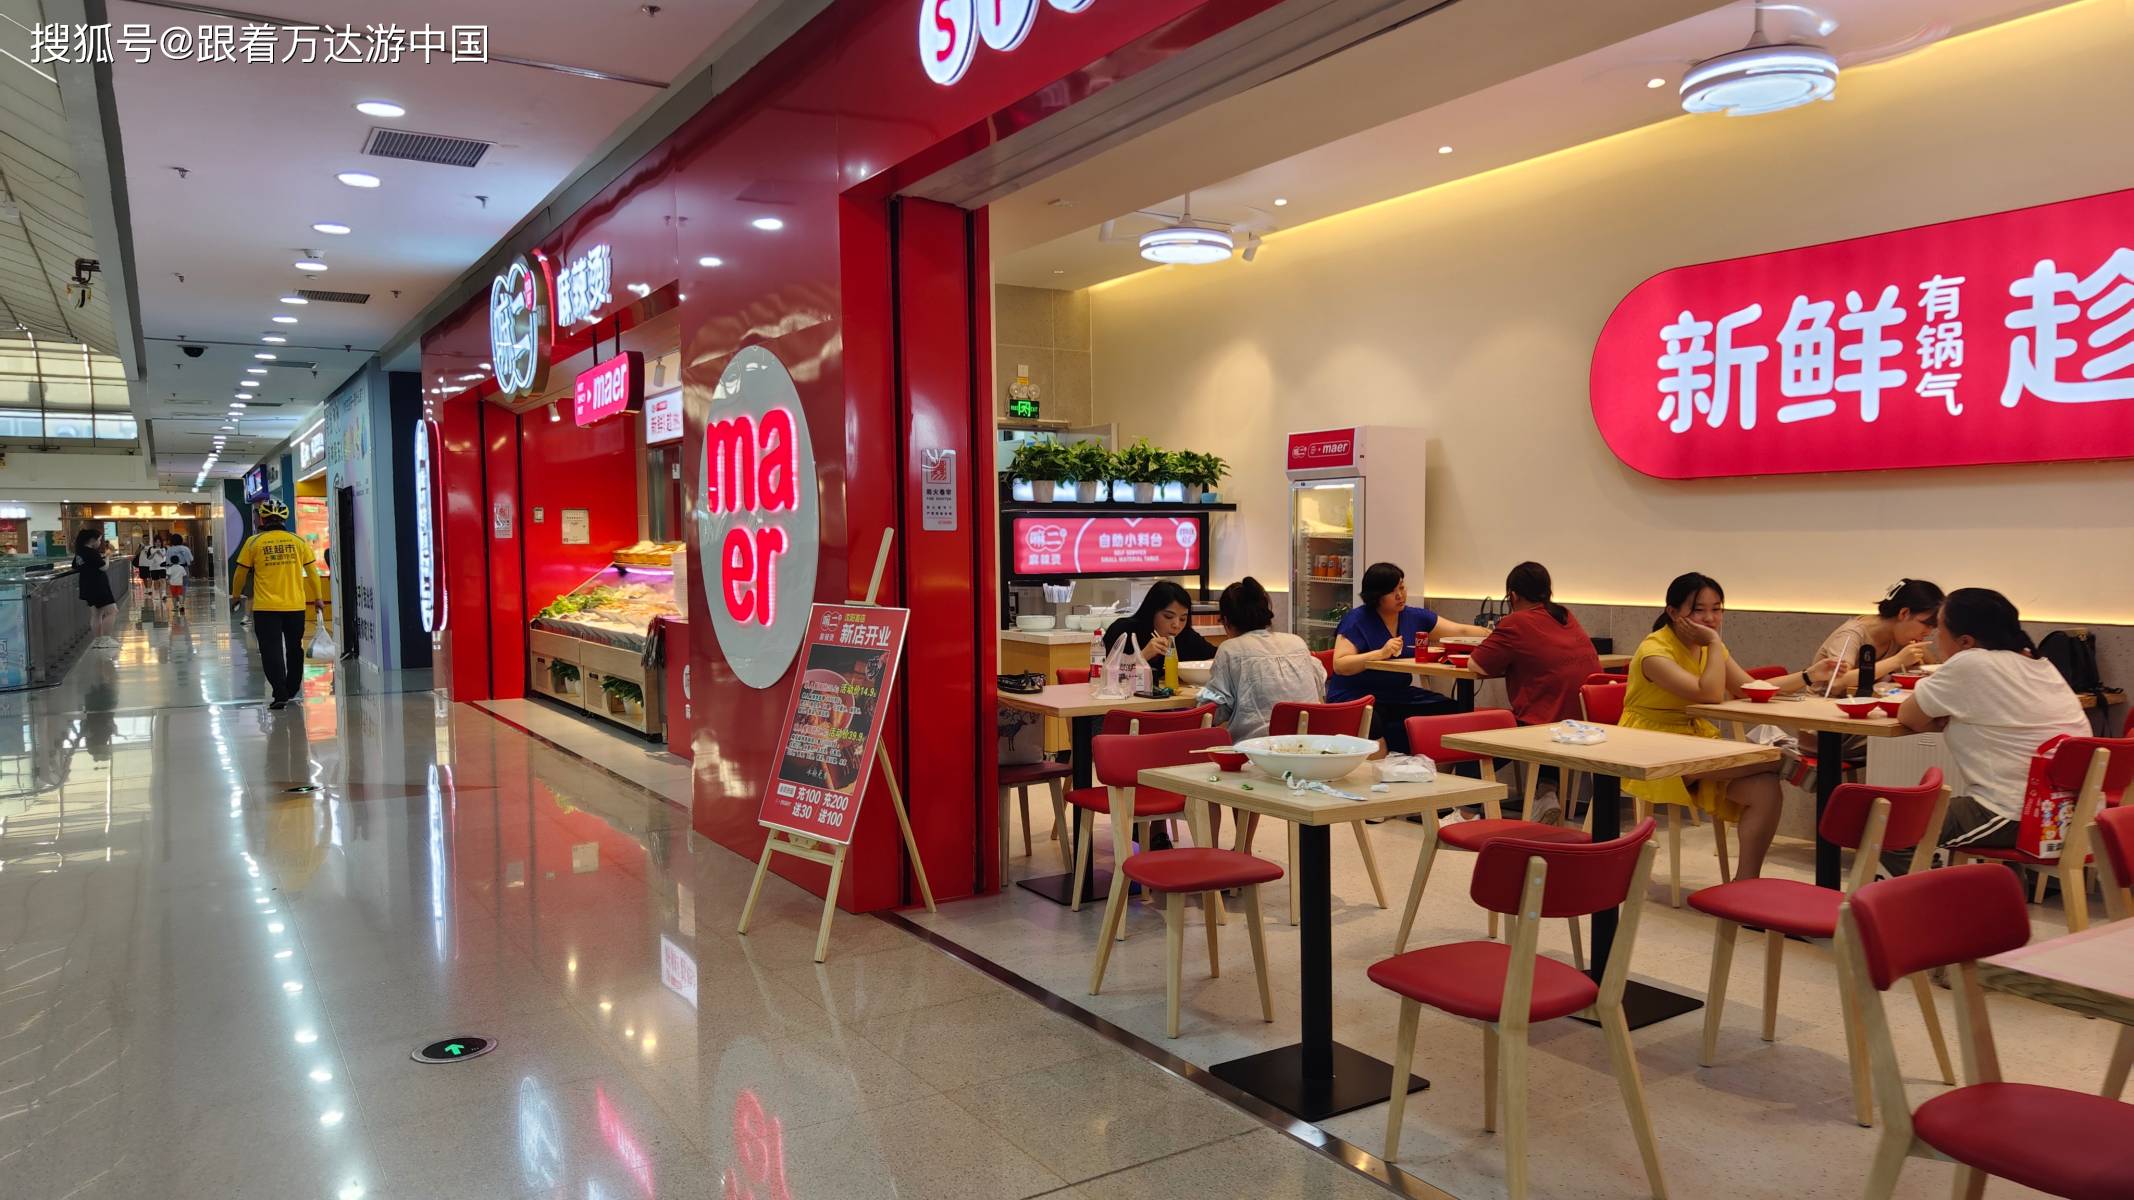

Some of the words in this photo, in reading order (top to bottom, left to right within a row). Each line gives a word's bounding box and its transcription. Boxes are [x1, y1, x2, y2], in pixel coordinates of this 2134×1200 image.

[1656, 284, 1909, 434] 新鲜
[1915, 274, 1966, 417] 有锅气
[592, 363, 627, 410] maer
[706, 408, 799, 514] ma
[1322, 443, 1348, 454] maer
[262, 544, 296, 555] 逛超市
[1099, 532, 1162, 549] 自助小料台
[722, 526, 787, 627] er
[839, 623, 892, 647] 新店开业
[796, 787, 822, 804] 充100
[822, 792, 849, 811] 充200
[791, 801, 813, 819] 送30
[817, 808, 844, 828] 送100
